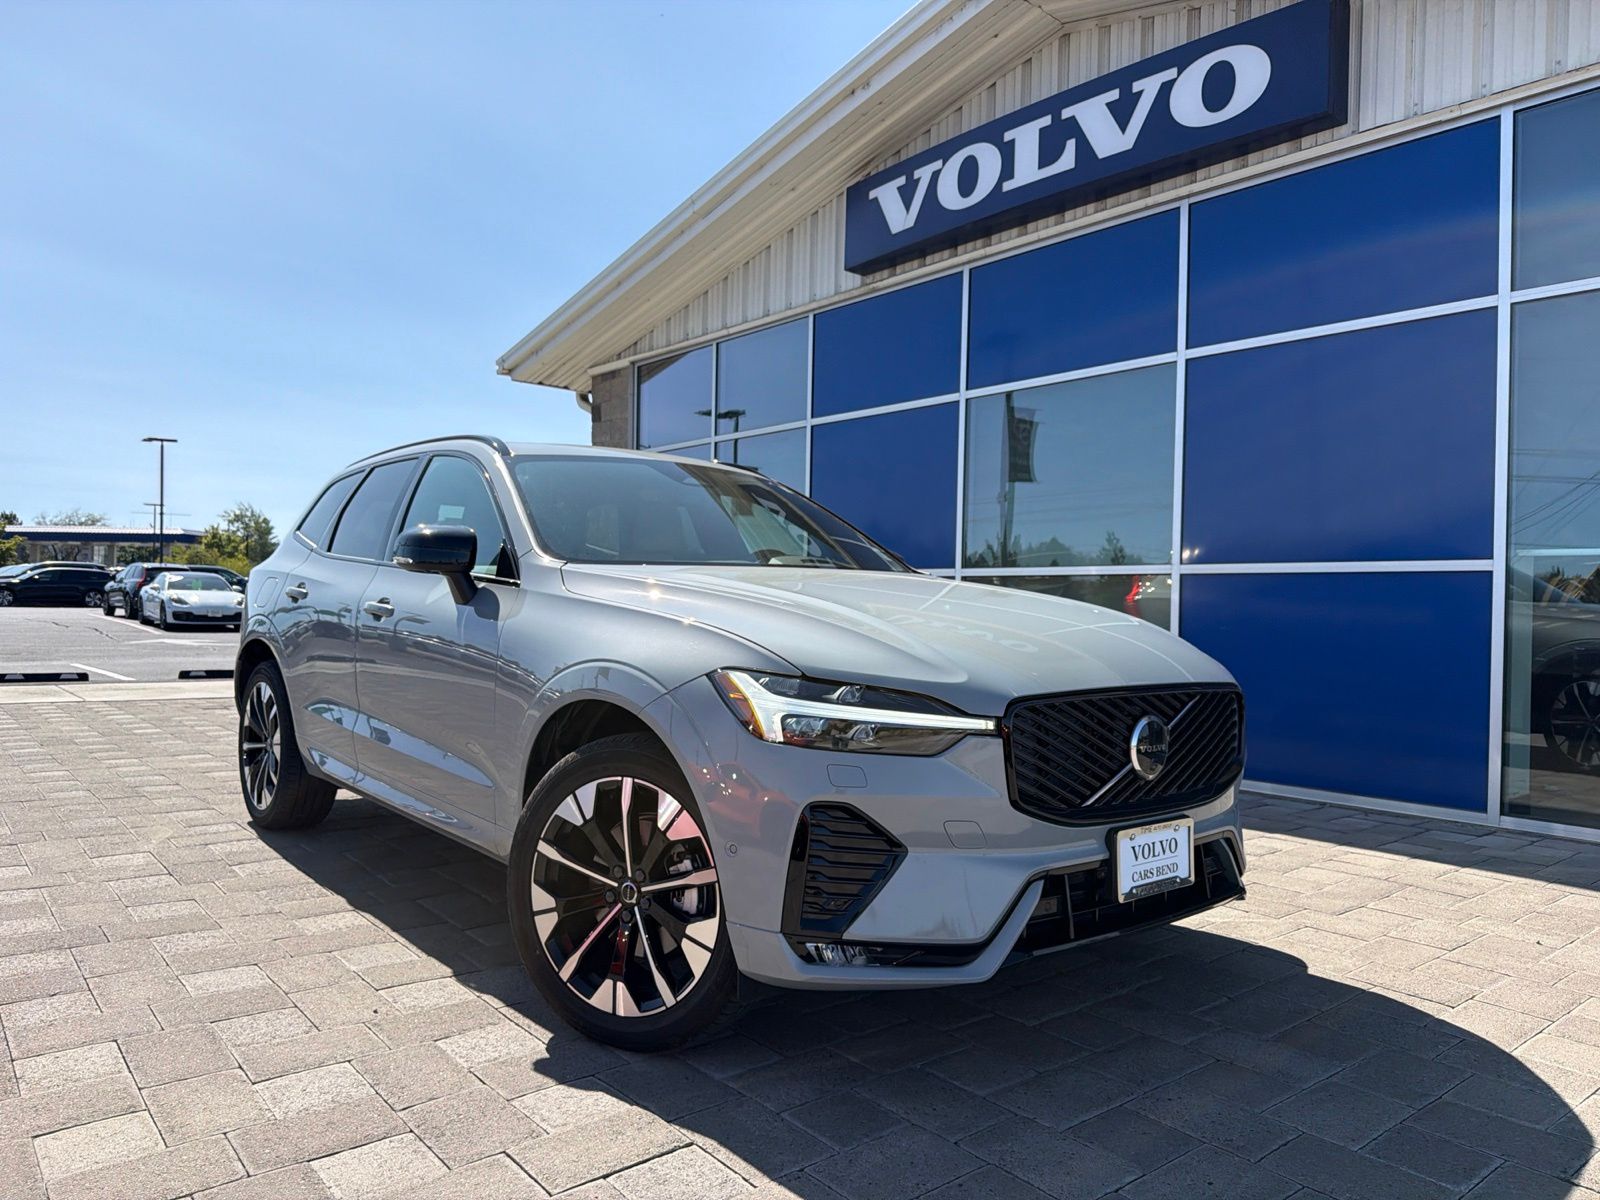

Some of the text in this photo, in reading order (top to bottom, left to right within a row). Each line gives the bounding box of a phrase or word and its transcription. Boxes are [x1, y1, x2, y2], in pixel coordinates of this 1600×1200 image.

[868, 44, 1272, 235] VOLVO
[1130, 837, 1178, 862] VOLVO
[1131, 862, 1179, 883] CARS BEND
